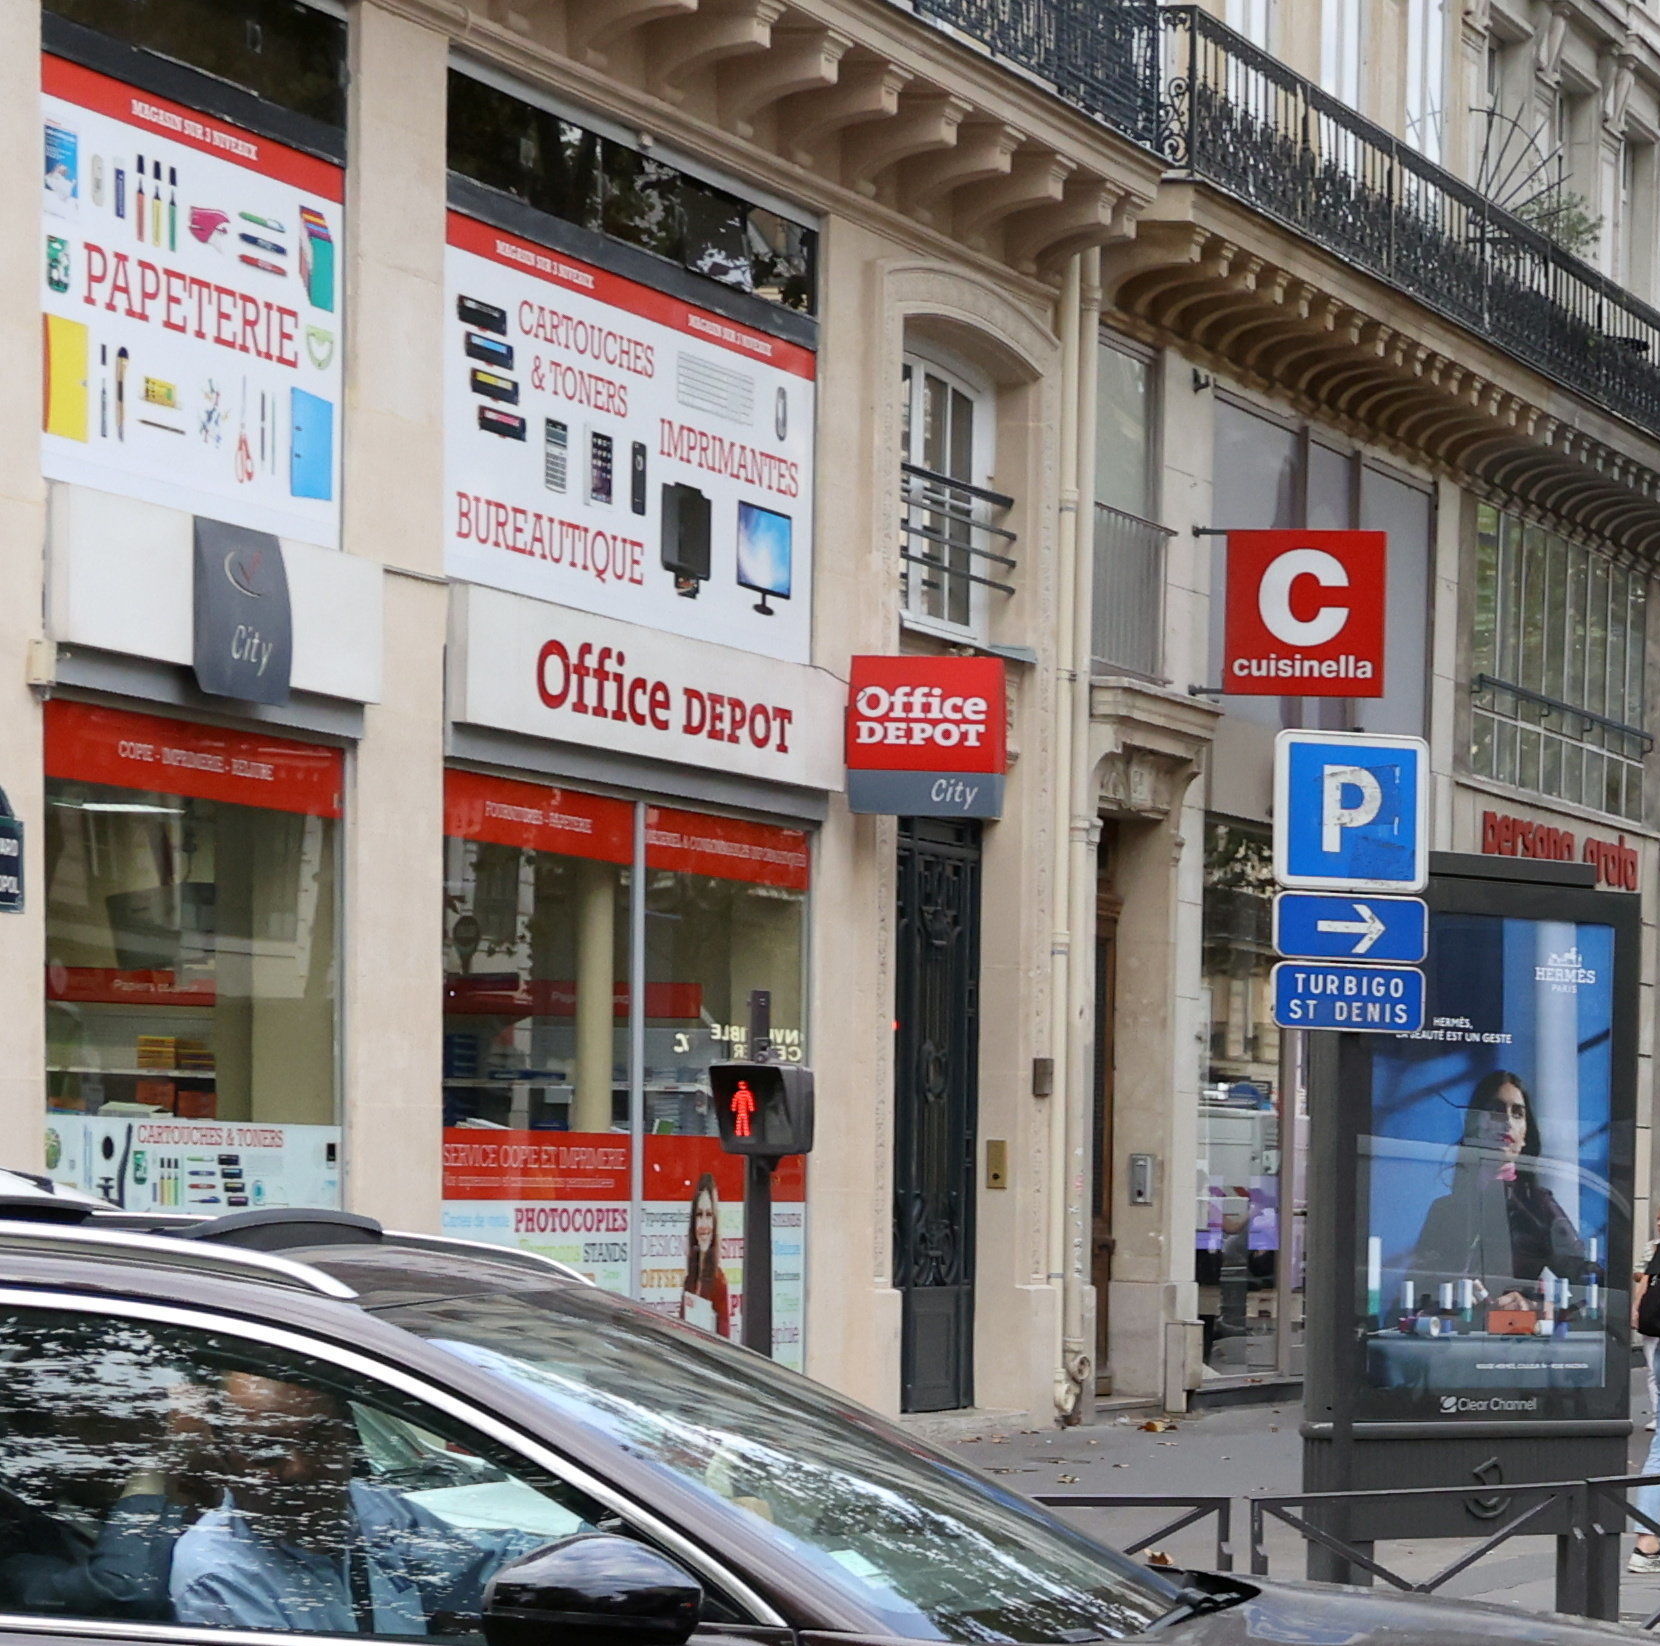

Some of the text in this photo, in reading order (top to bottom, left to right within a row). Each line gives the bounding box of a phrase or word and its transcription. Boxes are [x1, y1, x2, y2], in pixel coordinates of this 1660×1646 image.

[83, 241, 298, 369] PAPETERIE
[518, 299, 655, 379] CARTOUCHES
[530, 355, 629, 418] & TONERS
[659, 417, 799, 498] IMPRIMANTES
[455, 491, 645, 585] BUREAUTIQUE
[231, 624, 273, 676] City
[1233, 653, 1373, 679] cuisinella
[536, 639, 792, 754] Office DEPOT
[856, 686, 988, 721] Office
[855, 721, 987, 748] DEPOT
[118, 740, 154, 762] COPIE
[931, 778, 979, 809] City
[1322, 764, 1382, 852] P
[1295, 973, 1404, 998] TURBIGO
[1534, 966, 1596, 984] HERMÈS
[1551, 984, 1578, 994] PARIS
[1289, 999, 1408, 1024] ST DENIS
[1446, 1031, 1464, 1041] EST
[1465, 1032, 1481, 1042] UN
[1482, 1033, 1513, 1044] GESTE
[138, 1124, 284, 1148] CARTOUCHES & TONERS
[443, 1143, 627, 1169] SERVICE COPIE ET IMPRIMERIE
[513, 1207, 629, 1234] PHOTOCOPIES
[583, 1242, 628, 1263] STANDS
[1458, 1397, 1537, 1411] Clear Channel
